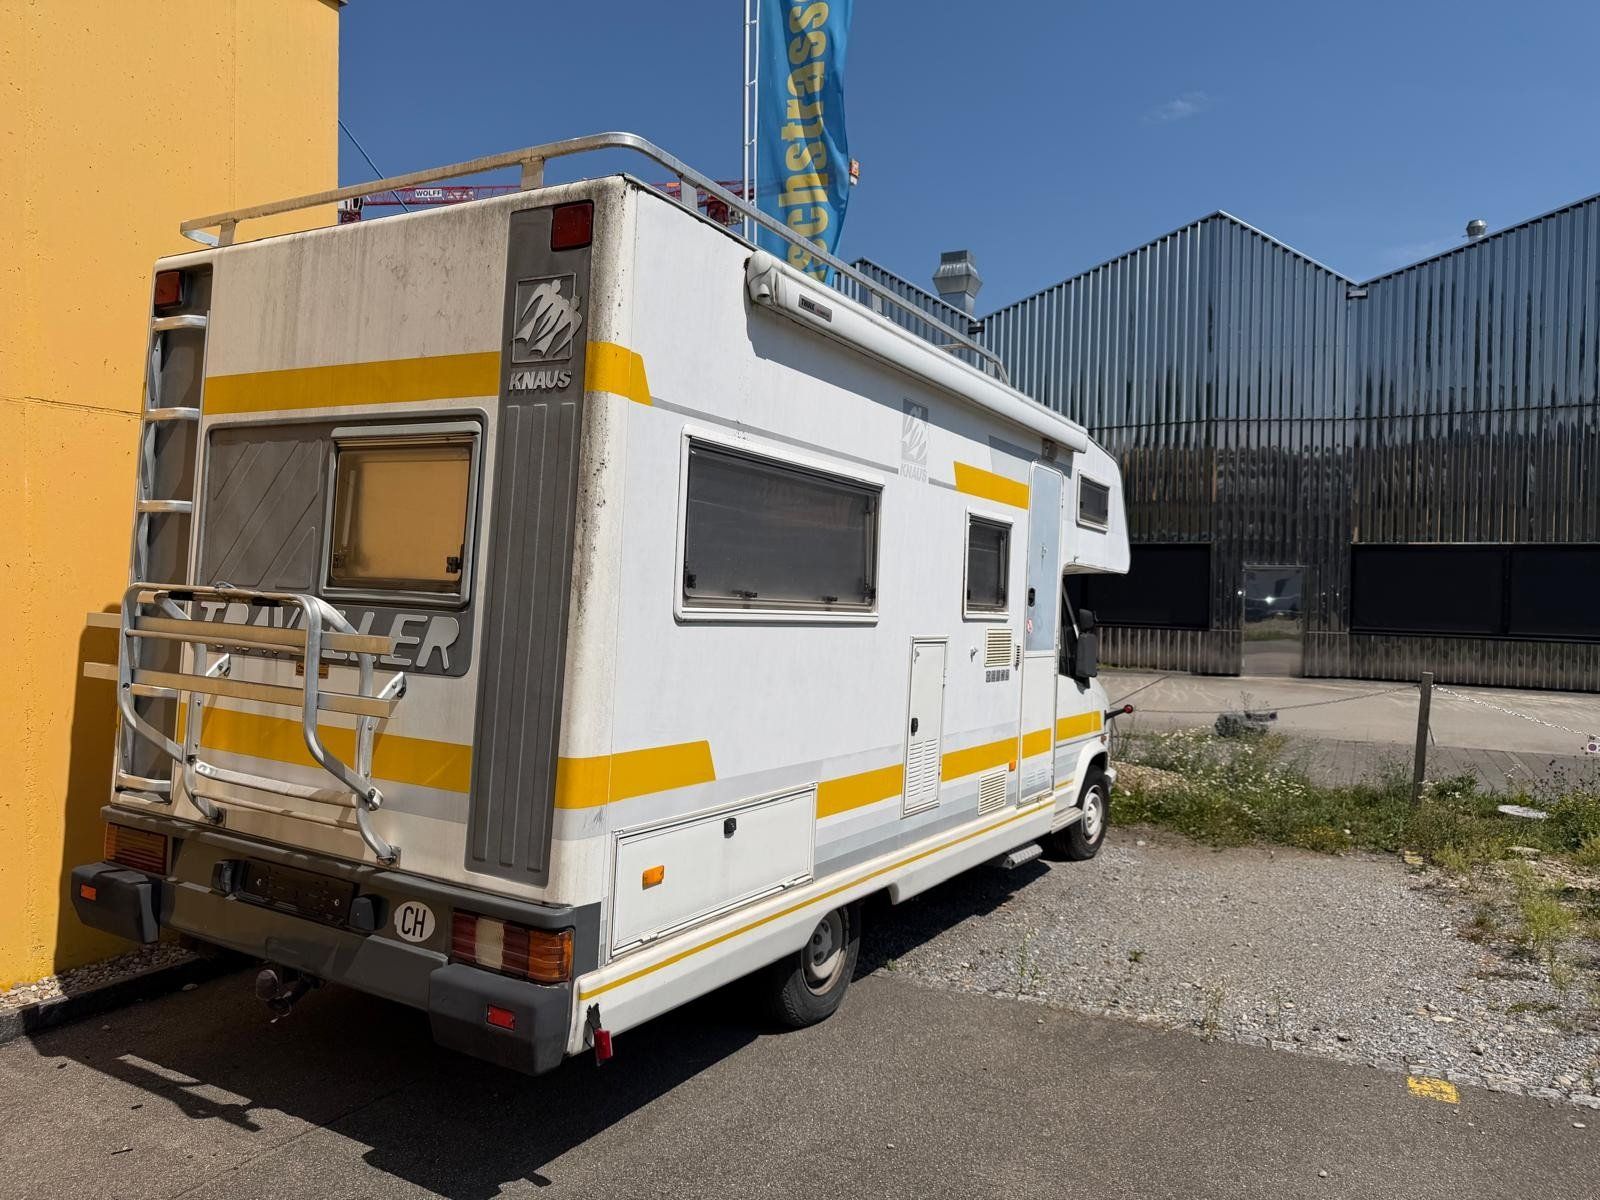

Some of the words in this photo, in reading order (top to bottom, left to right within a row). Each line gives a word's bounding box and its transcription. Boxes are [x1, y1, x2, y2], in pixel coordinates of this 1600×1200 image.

[778, 0, 830, 282] schstrass
[508, 369, 572, 391] KNAUS
[900, 463, 927, 482] KNAUS
[200, 601, 460, 669] TRAVLER
[401, 905, 427, 938] CH
